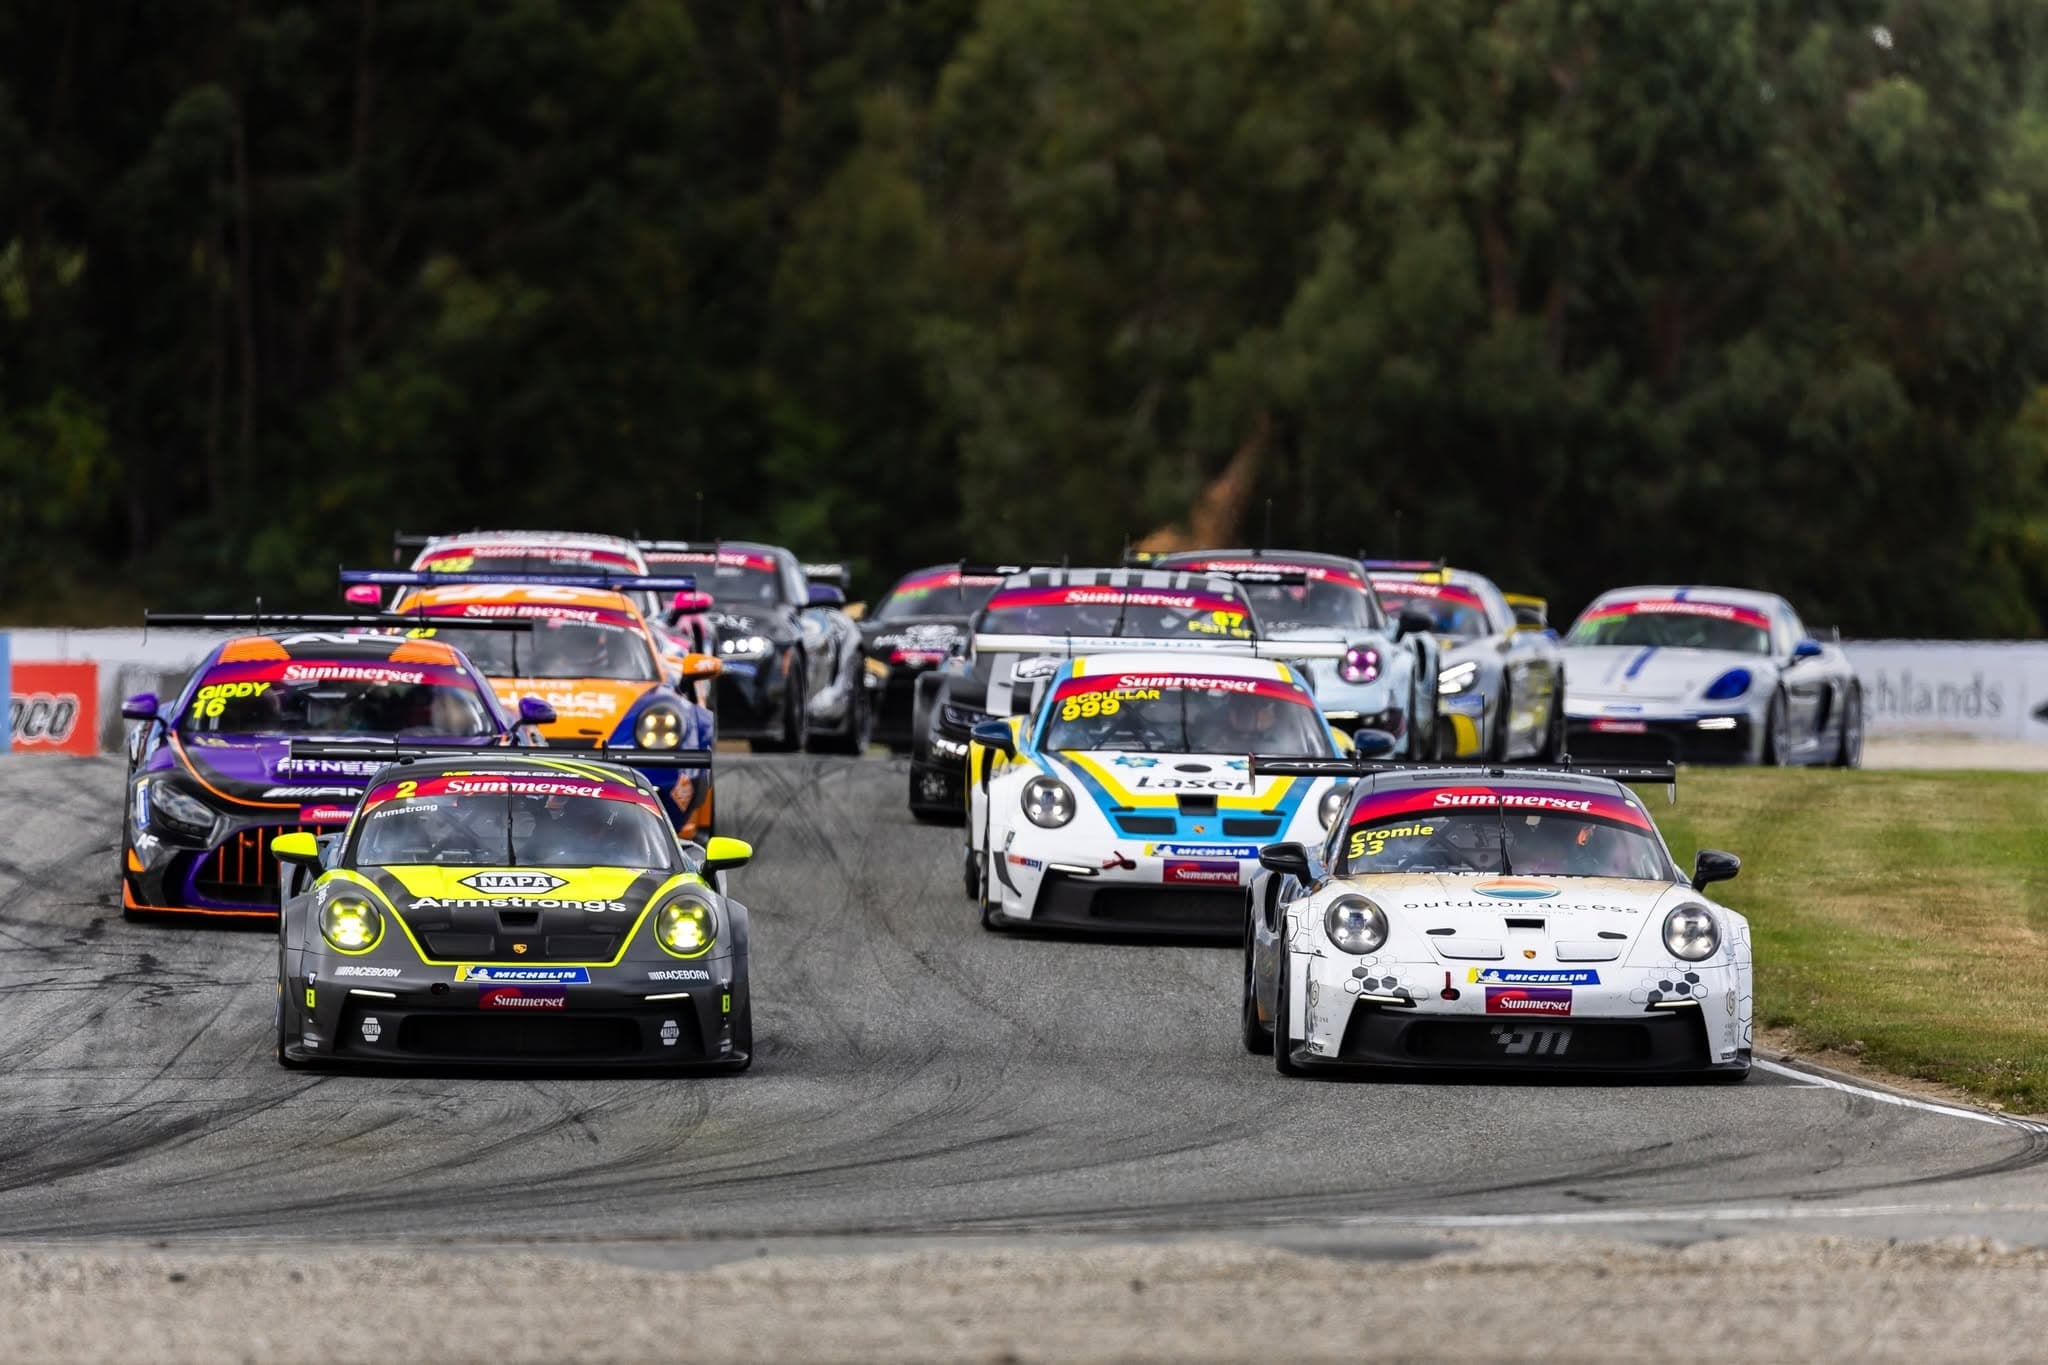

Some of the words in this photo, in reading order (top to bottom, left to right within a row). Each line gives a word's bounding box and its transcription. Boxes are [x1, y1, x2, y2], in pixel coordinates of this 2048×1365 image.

[1065, 590, 1196, 608] Summerset
[463, 604, 598, 622] Summerset
[283, 664, 425, 684] Summerset
[197, 682, 271, 700] GIDDY
[1117, 675, 1257, 693] Summerset
[1065, 689, 1160, 705] SCOULLAR
[192, 697, 226, 719] 16
[1062, 699, 1120, 721] 999
[277, 757, 394, 773] FITNES
[395, 780, 418, 799] 2
[445, 780, 604, 798] Summerset
[1136, 776, 1250, 790] Laser
[1433, 793, 1592, 812] Summerset
[374, 804, 438, 819] Armstrong
[1351, 823, 1435, 843] Cromie
[1176, 847, 1250, 857] MICHELIN
[1347, 840, 1384, 859] 33
[480, 876, 550, 887] NAPA
[1175, 868, 1238, 881] Summerset
[408, 896, 627, 912] Armstrong's
[1403, 900, 1528, 910] outdoor
[1538, 903, 1640, 915] access
[345, 966, 402, 978] RACEBORN
[493, 970, 577, 980] MICHELIN
[659, 969, 710, 980] RACEBORN
[1505, 973, 1588, 982] MICHELIN
[493, 994, 565, 1008] Summerset
[1500, 996, 1571, 1011] Summerset
